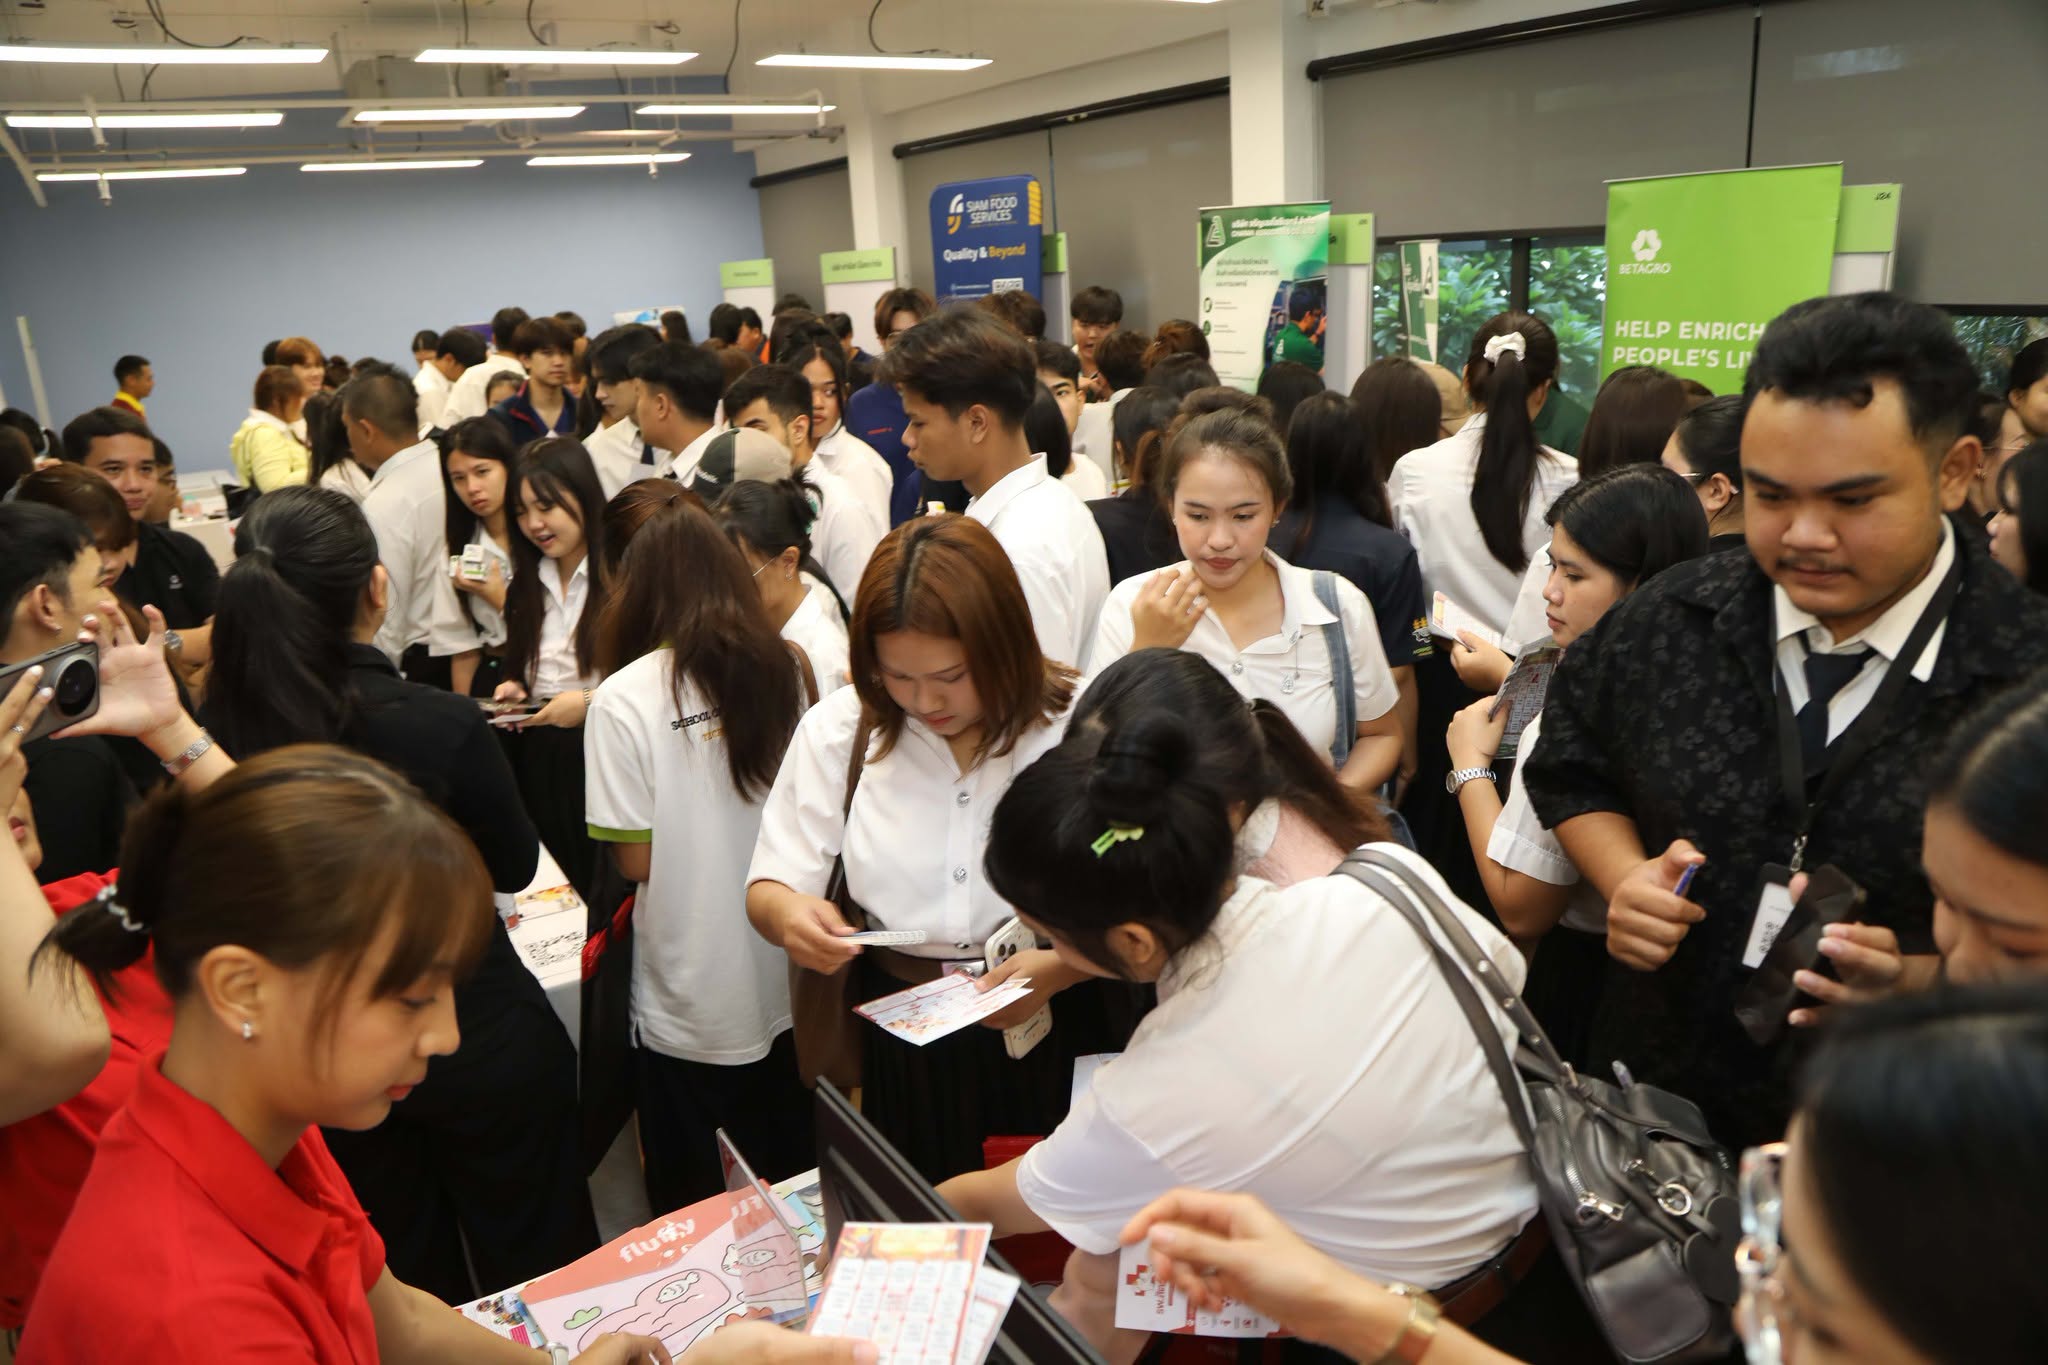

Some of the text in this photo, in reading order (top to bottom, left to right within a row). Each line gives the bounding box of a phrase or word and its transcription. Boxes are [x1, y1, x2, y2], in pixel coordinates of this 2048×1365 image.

[990, 196, 1018, 210] FOOD
[970, 209, 1012, 223] SERVICES
[943, 242, 1026, 262] Quality & Beyond
[1618, 262, 1672, 275] BETAGRO
[1615, 320, 1767, 341] HELP ENRICH
[1612, 346, 1720, 367] PEOPLE'S
[619, 1218, 696, 1263] fluffy
